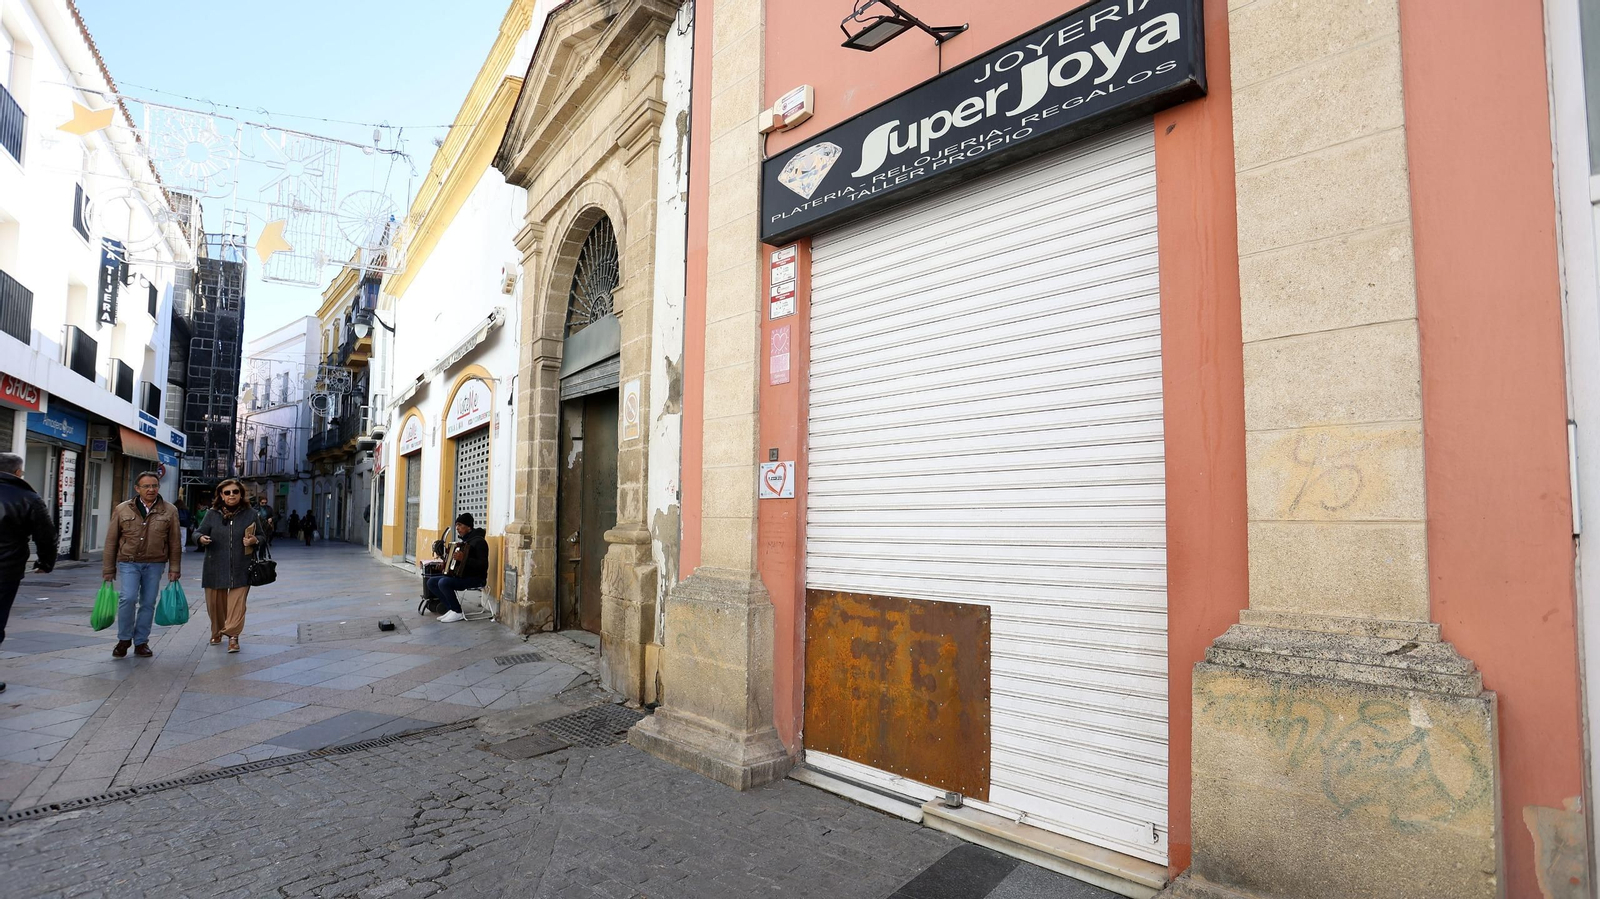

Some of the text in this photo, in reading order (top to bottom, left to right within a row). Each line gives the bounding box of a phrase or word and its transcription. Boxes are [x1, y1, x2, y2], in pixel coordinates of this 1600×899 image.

[771, 186, 854, 222] PLATERIA
[1022, 60, 1177, 126] REGALOS
[847, 128, 1033, 201] TALLER PROPIO
[101, 265, 114, 321] TIJERA
